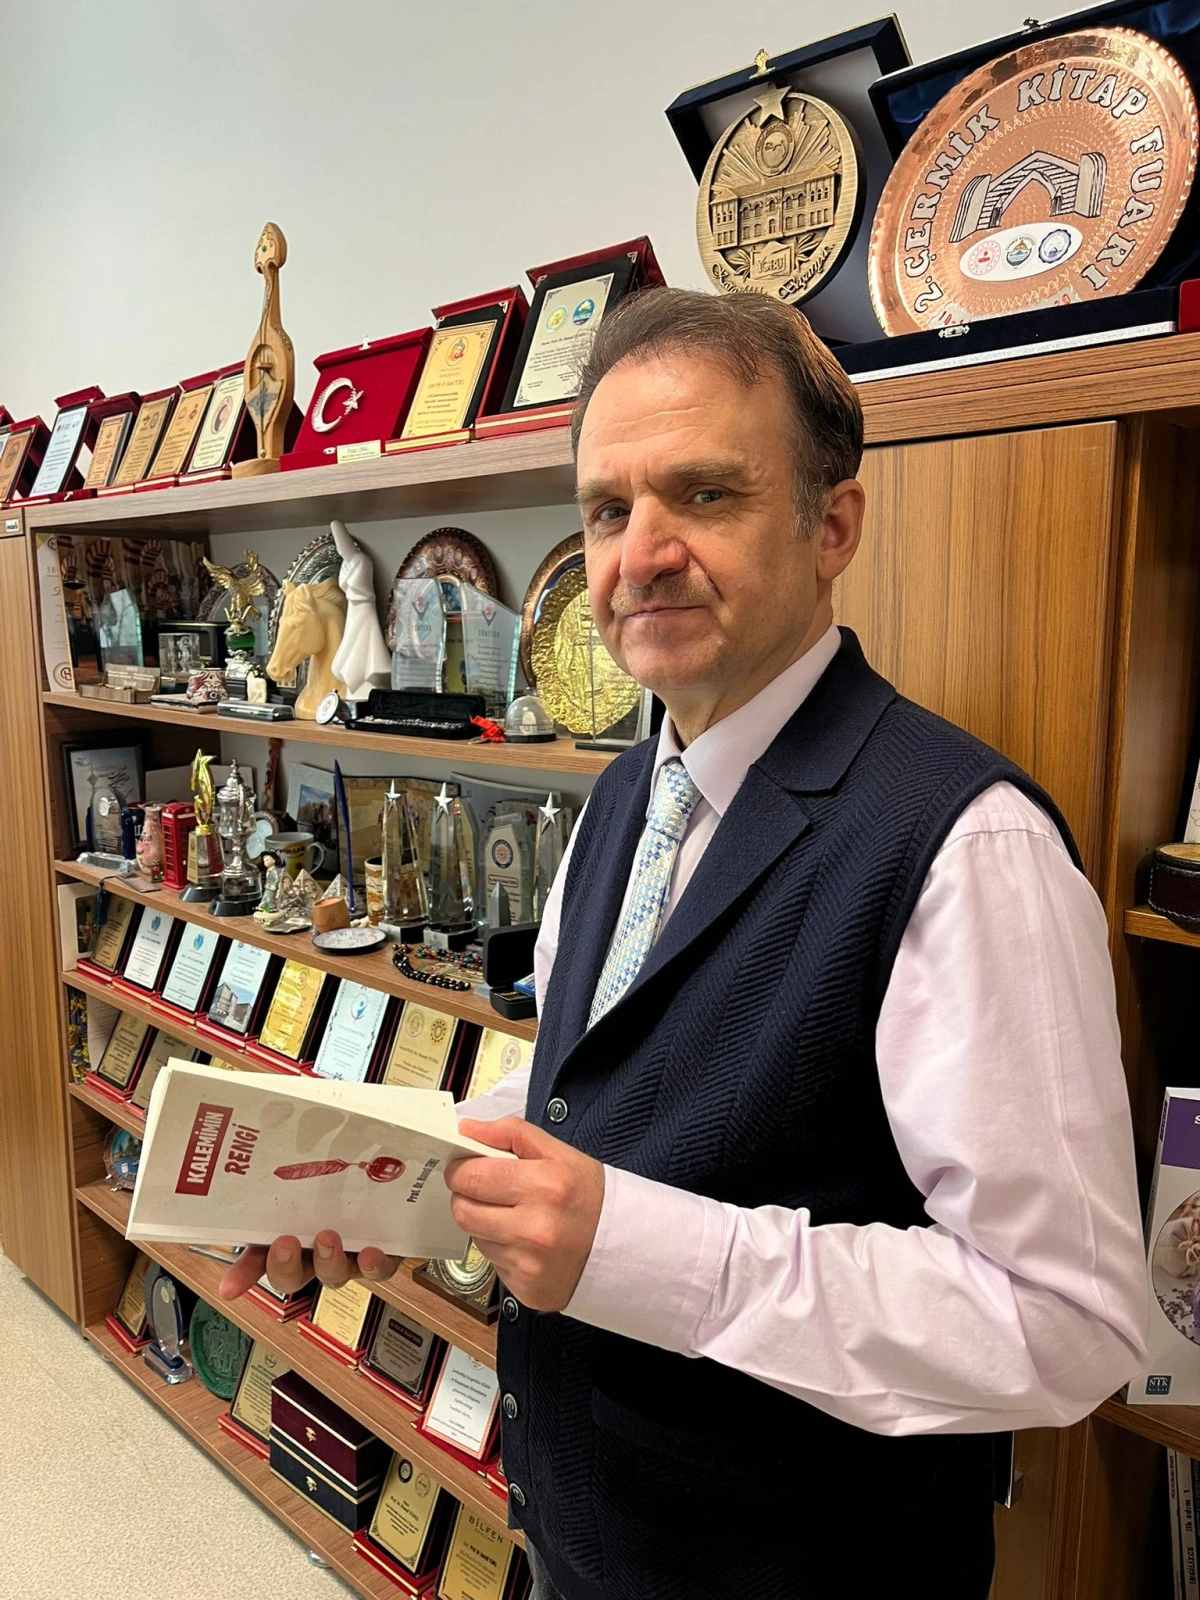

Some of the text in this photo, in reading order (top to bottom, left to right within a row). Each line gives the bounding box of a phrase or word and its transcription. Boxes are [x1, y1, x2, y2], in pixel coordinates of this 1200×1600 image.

[1017, 63, 1147, 119] KİTAP
[1081, 126, 1164, 290] FUARI
[187, 1111, 224, 1184] KALEMİMİN
[224, 1123, 260, 1175] RENGİ
